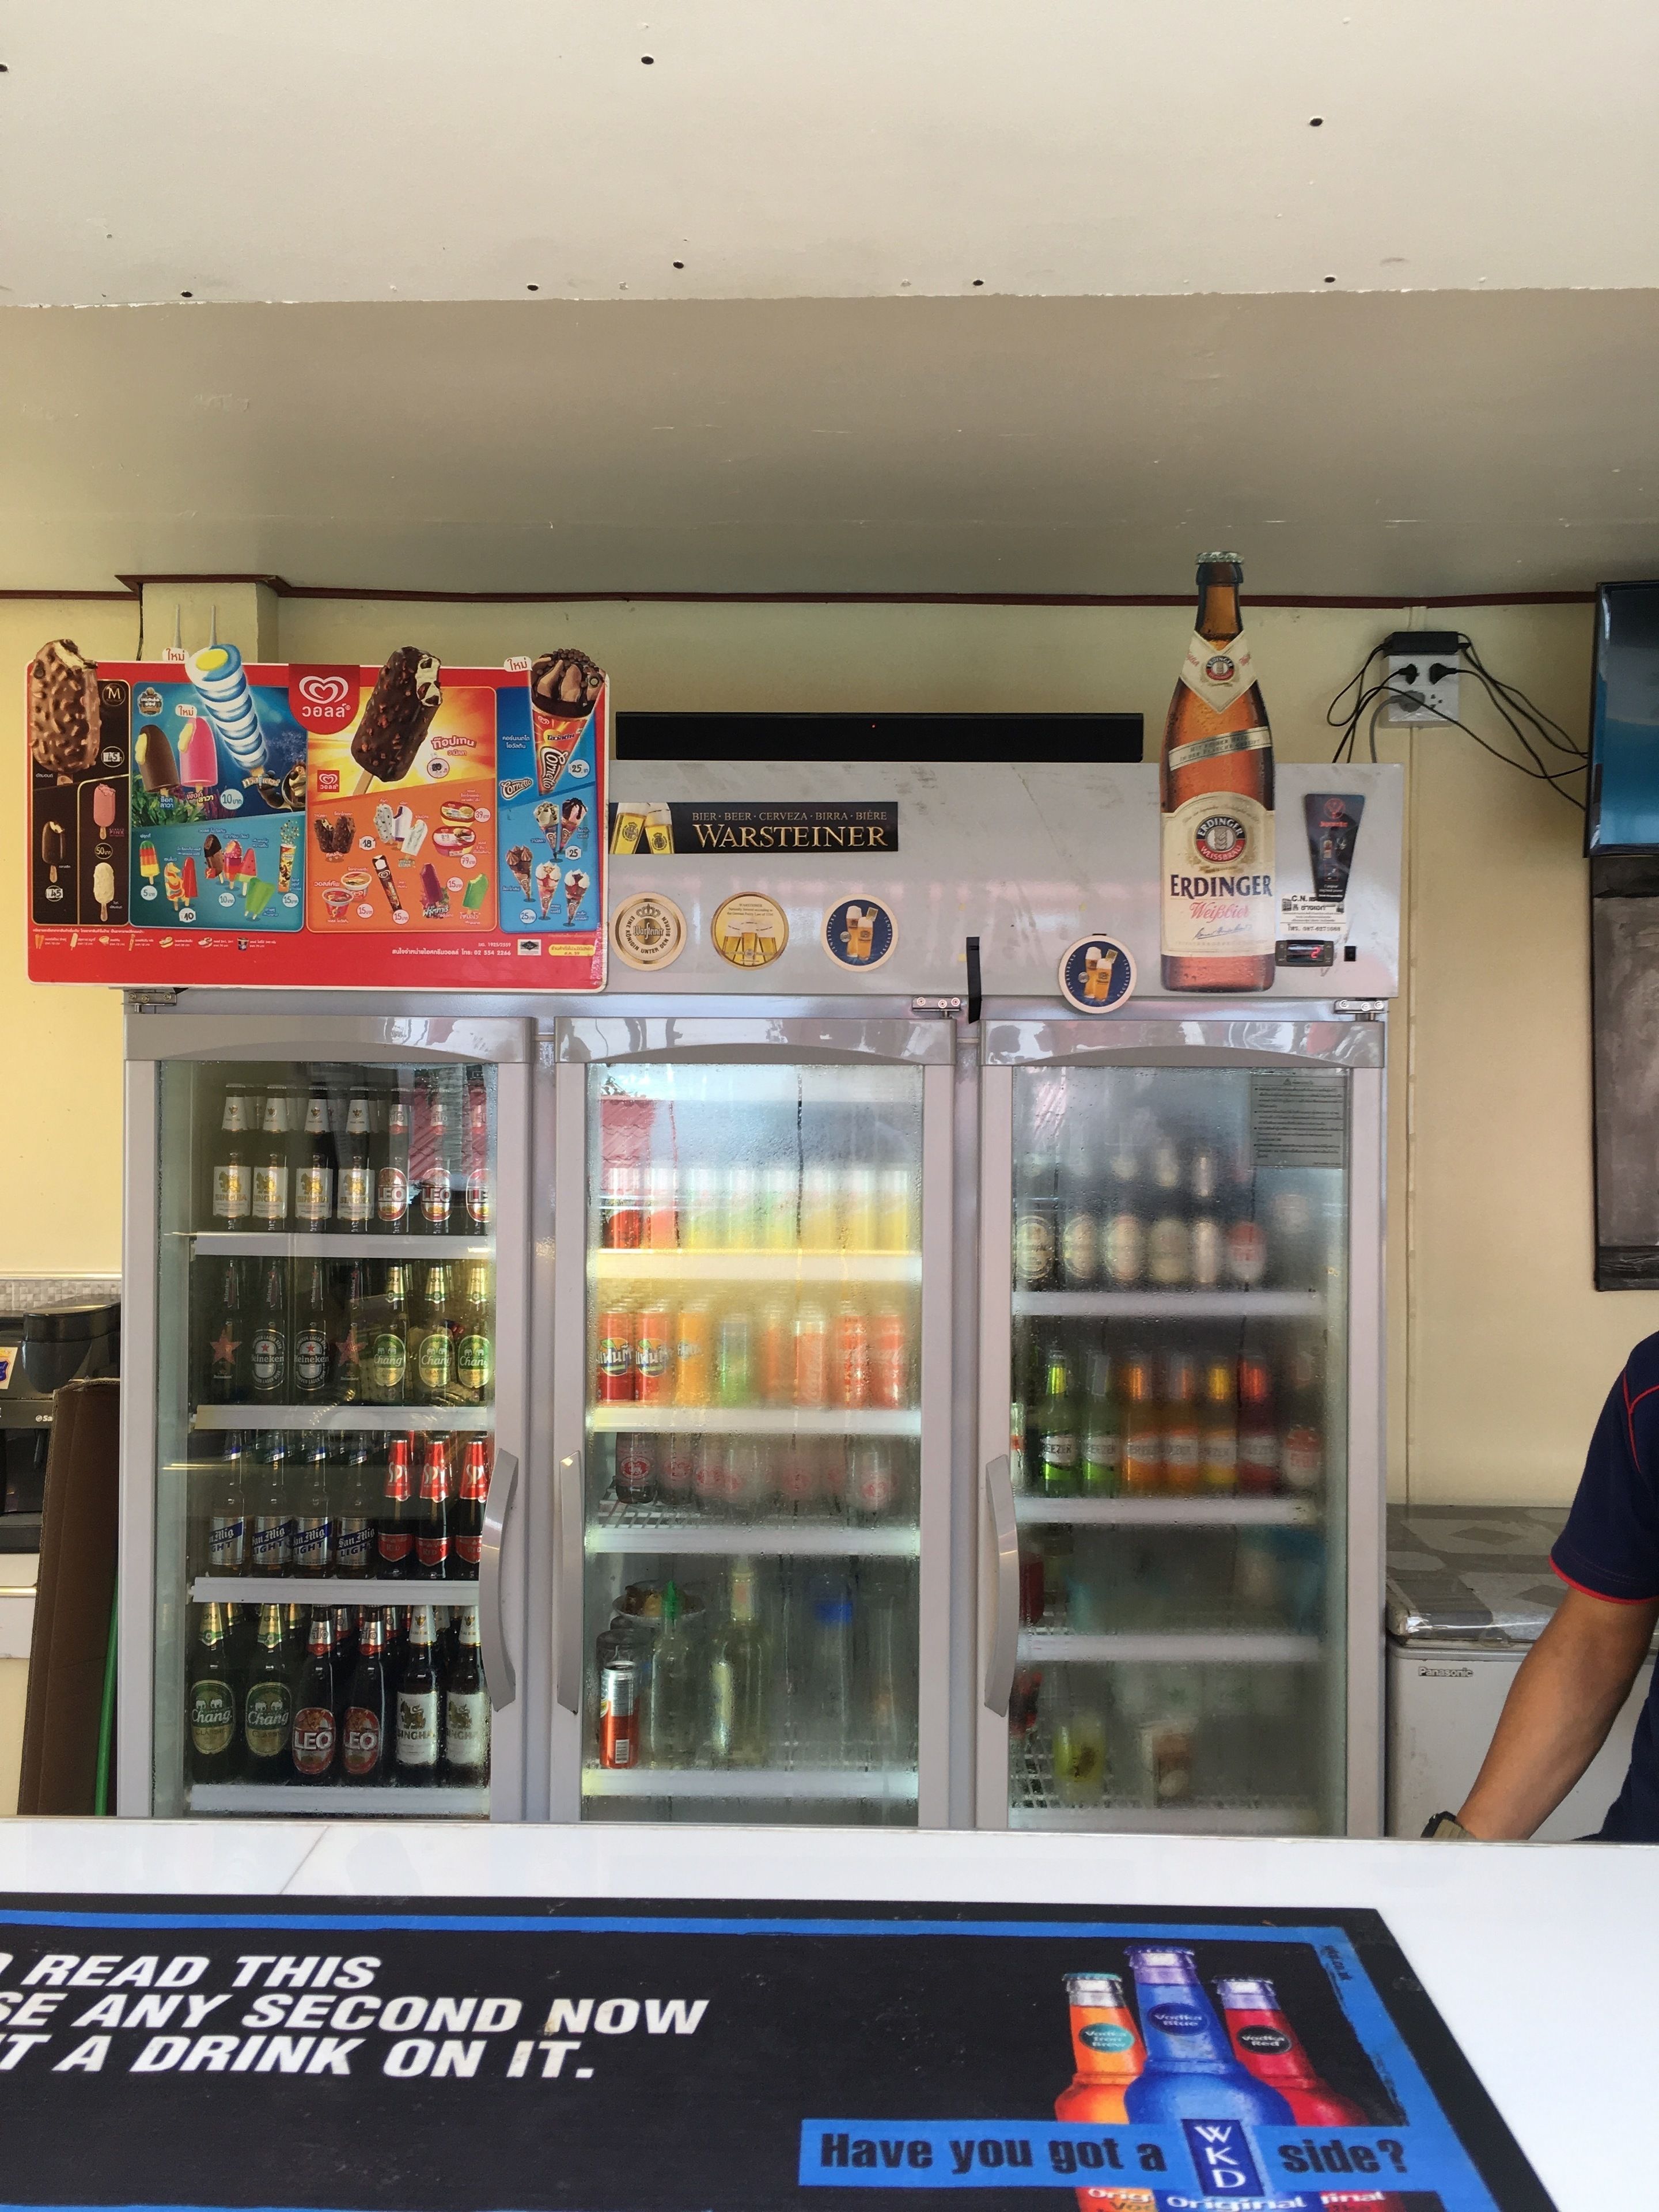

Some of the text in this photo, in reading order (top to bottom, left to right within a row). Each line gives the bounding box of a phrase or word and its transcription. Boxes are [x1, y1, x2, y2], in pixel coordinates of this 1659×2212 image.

[165, 648, 185, 661] ใหม่
[506, 657, 528, 671] ใหม่
[177, 705, 194, 716] ใหม่
[571, 764, 582, 773] 25
[501, 778, 532, 798] Cornetto
[222, 793, 232, 805] 10
[475, 810, 483, 819] 39
[692, 812, 717, 821] BIER
[724, 812, 751, 821] BEER
[759, 812, 808, 821] CERVEZA
[815, 812, 849, 821] BIRRA
[1197, 817, 1243, 836] ERDINGER
[692, 823, 889, 849] WARSTEINER
[362, 839, 373, 849] 18
[95, 847, 104, 855] 50
[569, 849, 579, 858] 25
[448, 880, 456, 888] 15
[1170, 874, 1273, 899] ERDINGER
[143, 889, 148, 897] 5
[219, 896, 228, 904] 10
[284, 896, 291, 904] 15
[184, 912, 194, 921] 10
[358, 907, 366, 915] 15
[393, 912, 402, 921] 15
[521, 912, 529, 921] 25
[626, 915, 635, 929] EINE
[661, 916, 671, 937] BIEREN
[625, 930, 640, 951] KÖNIGIN
[659, 938, 669, 949] DEN
[378, 1186, 407, 1202] LEO
[422, 1186, 452, 1203] LEO
[468, 1188, 489, 1203] LE
[374, 1354, 403, 1367] Chang
[421, 1354, 452, 1367] Chang
[460, 1355, 488, 1367] Chang
[215, 1529, 234, 1542] Mig
[264, 1527, 286, 1542] Mig
[304, 1529, 325, 1543] Mig
[338, 1527, 375, 1548] San Mig
[211, 1541, 233, 1552] GHT
[1418, 1666, 1474, 1677] Panasonic
[192, 1709, 233, 1723] Chang
[248, 1711, 289, 1726] Chang
[294, 1730, 333, 1750] LEO
[20, 1955, 211, 1987] READ
[231, 1956, 382, 1990] THIS
[70, 1993, 234, 2028] ANY
[241, 1993, 522, 2033] SECOND
[543, 1998, 711, 2035] NOW
[1153, 2013, 1203, 2022] Vodka
[1162, 2020, 1199, 2028] Blue
[1084, 2030, 1127, 2038] Vodka
[1241, 2035, 1286, 2043] Vodka
[1091, 2040, 1126, 2048] Brew
[1250, 2040, 1281, 2048] Red
[52, 2035, 113, 2072] A
[128, 2035, 368, 2075] DRINK
[381, 2039, 490, 2078] ON
[505, 2040, 596, 2079] IT.
[820, 2124, 1409, 2189] Have you got a WKD side?
[1166, 2195, 1308, 2211] Original
